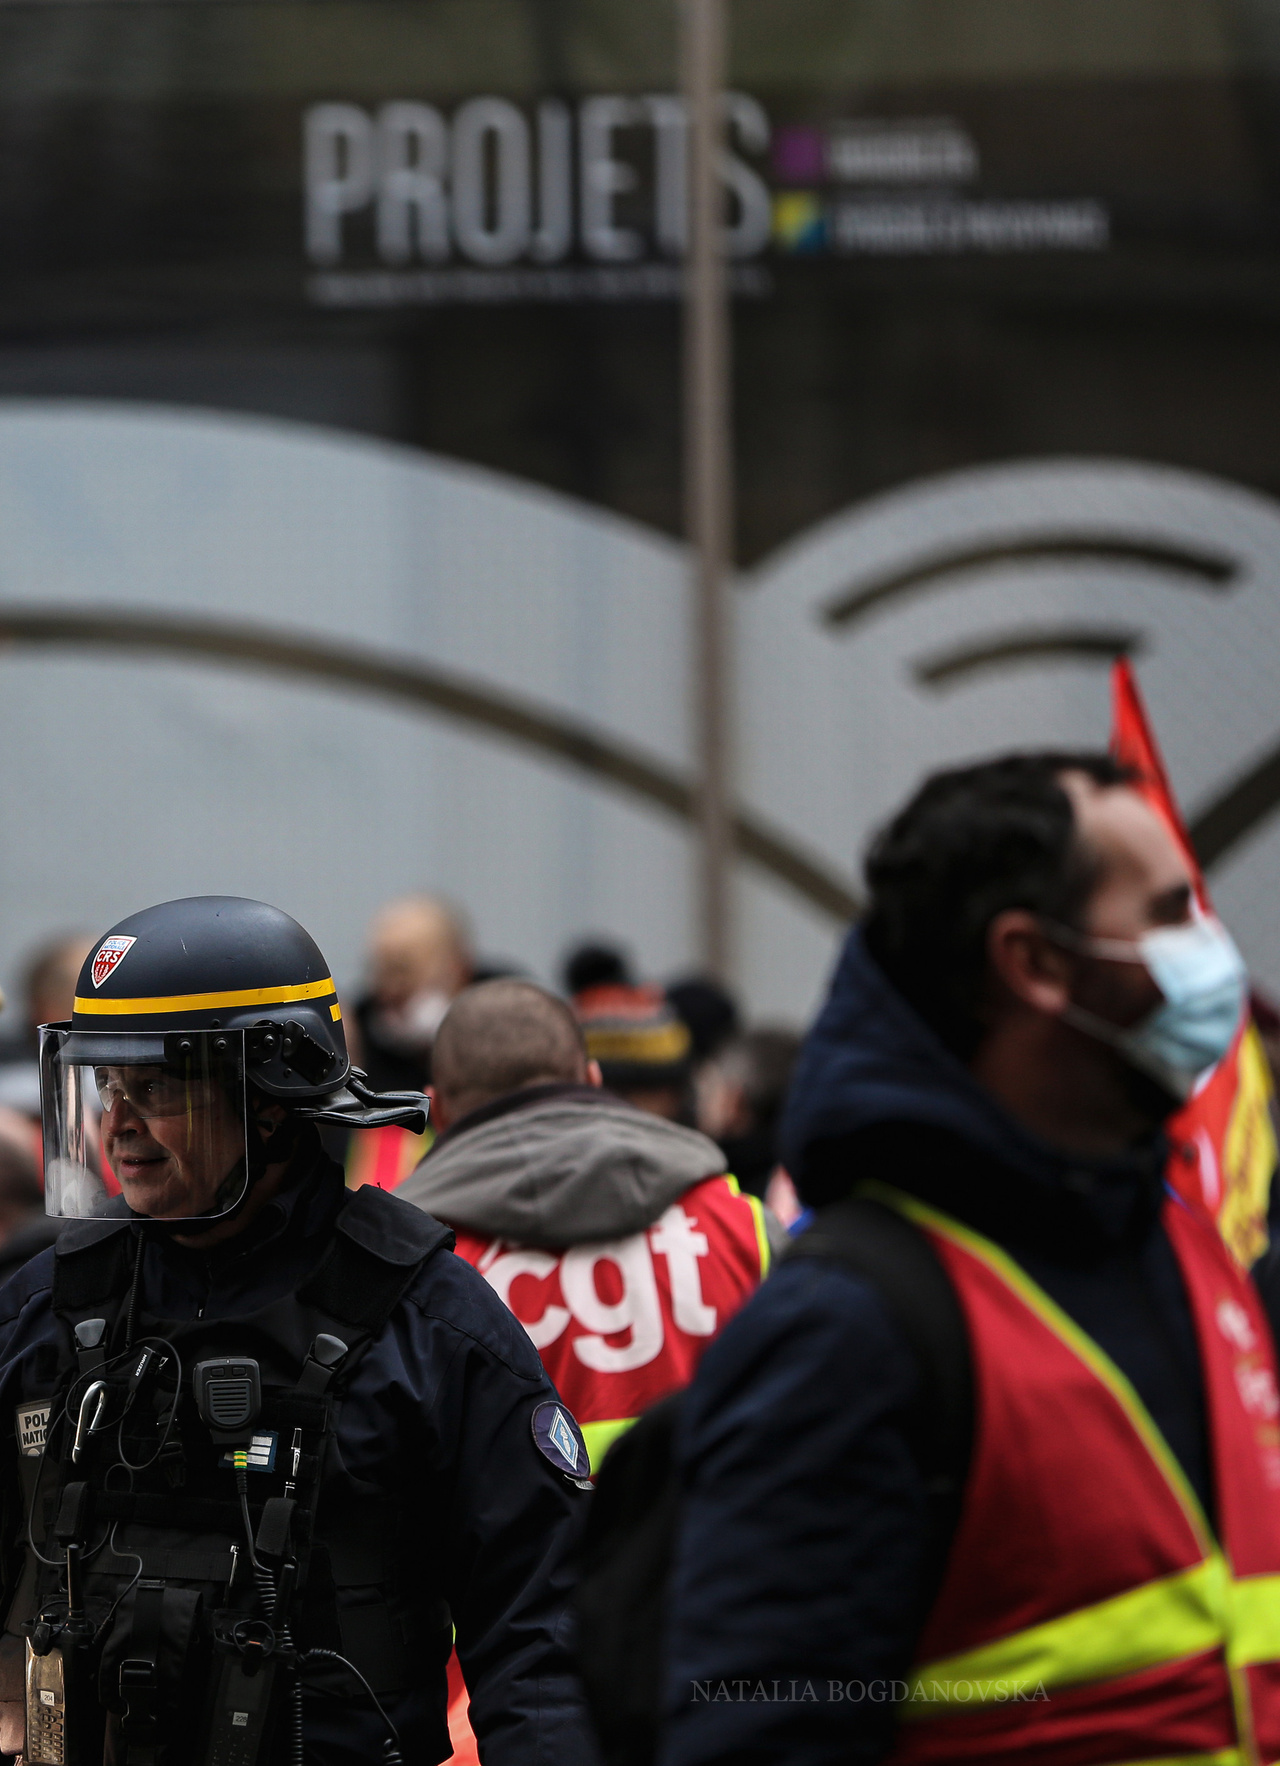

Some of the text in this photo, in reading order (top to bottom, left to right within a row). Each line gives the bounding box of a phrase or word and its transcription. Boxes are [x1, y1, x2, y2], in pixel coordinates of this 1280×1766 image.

[304, 93, 772, 264] PROJETS
[96, 950, 121, 964] CRS
[483, 1203, 717, 1373] cgt
